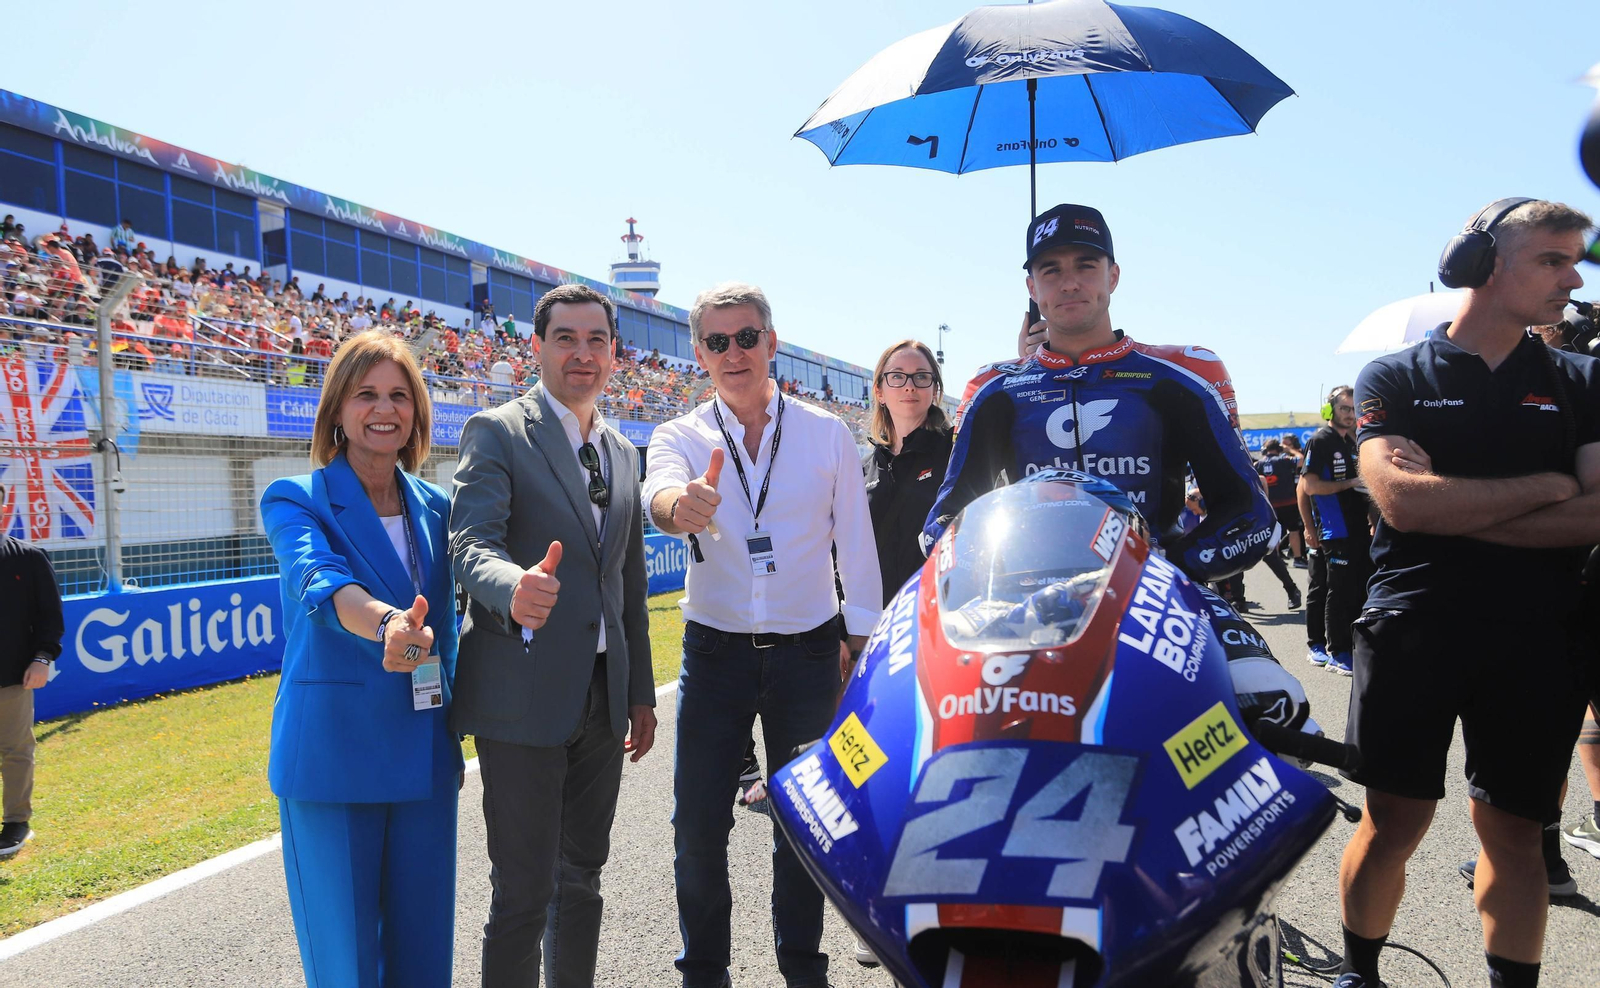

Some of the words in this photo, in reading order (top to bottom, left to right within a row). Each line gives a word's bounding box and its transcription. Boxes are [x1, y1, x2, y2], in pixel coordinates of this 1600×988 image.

[996, 49, 1086, 65] OnlyFans
[54, 108, 159, 166] Andalucía
[213, 162, 291, 205] Andalucía
[325, 196, 387, 233] Andalucía
[1032, 217, 1059, 248] 24
[1074, 224, 1100, 236] NUTRITION
[418, 225, 468, 257] Andalucía
[1086, 338, 1134, 361] MACNA
[181, 385, 250, 406] Diputación
[1002, 373, 1047, 386] FAMILY
[1016, 390, 1042, 398] RIDER'S
[182, 408, 198, 423] de
[204, 408, 239, 426] Cádiz
[1423, 398, 1464, 408] OnlyFans
[1222, 527, 1272, 560] OnlyFans
[888, 574, 921, 676] LATAM
[1118, 553, 1174, 655] LATAM
[75, 592, 276, 673] Galicia
[1153, 596, 1197, 674] BOX
[1183, 625, 1209, 683] COMPANY
[1199, 608, 1211, 630] INC
[938, 687, 1077, 720] OnlyFans
[835, 720, 871, 773] Hertz
[1174, 718, 1235, 774] Hertz
[782, 777, 834, 854] POWERSPORTS
[791, 753, 860, 841] FAMILY
[1174, 756, 1282, 868] FAMILY
[883, 747, 1139, 900] 24
[1206, 789, 1297, 877] POWERSPORTS
